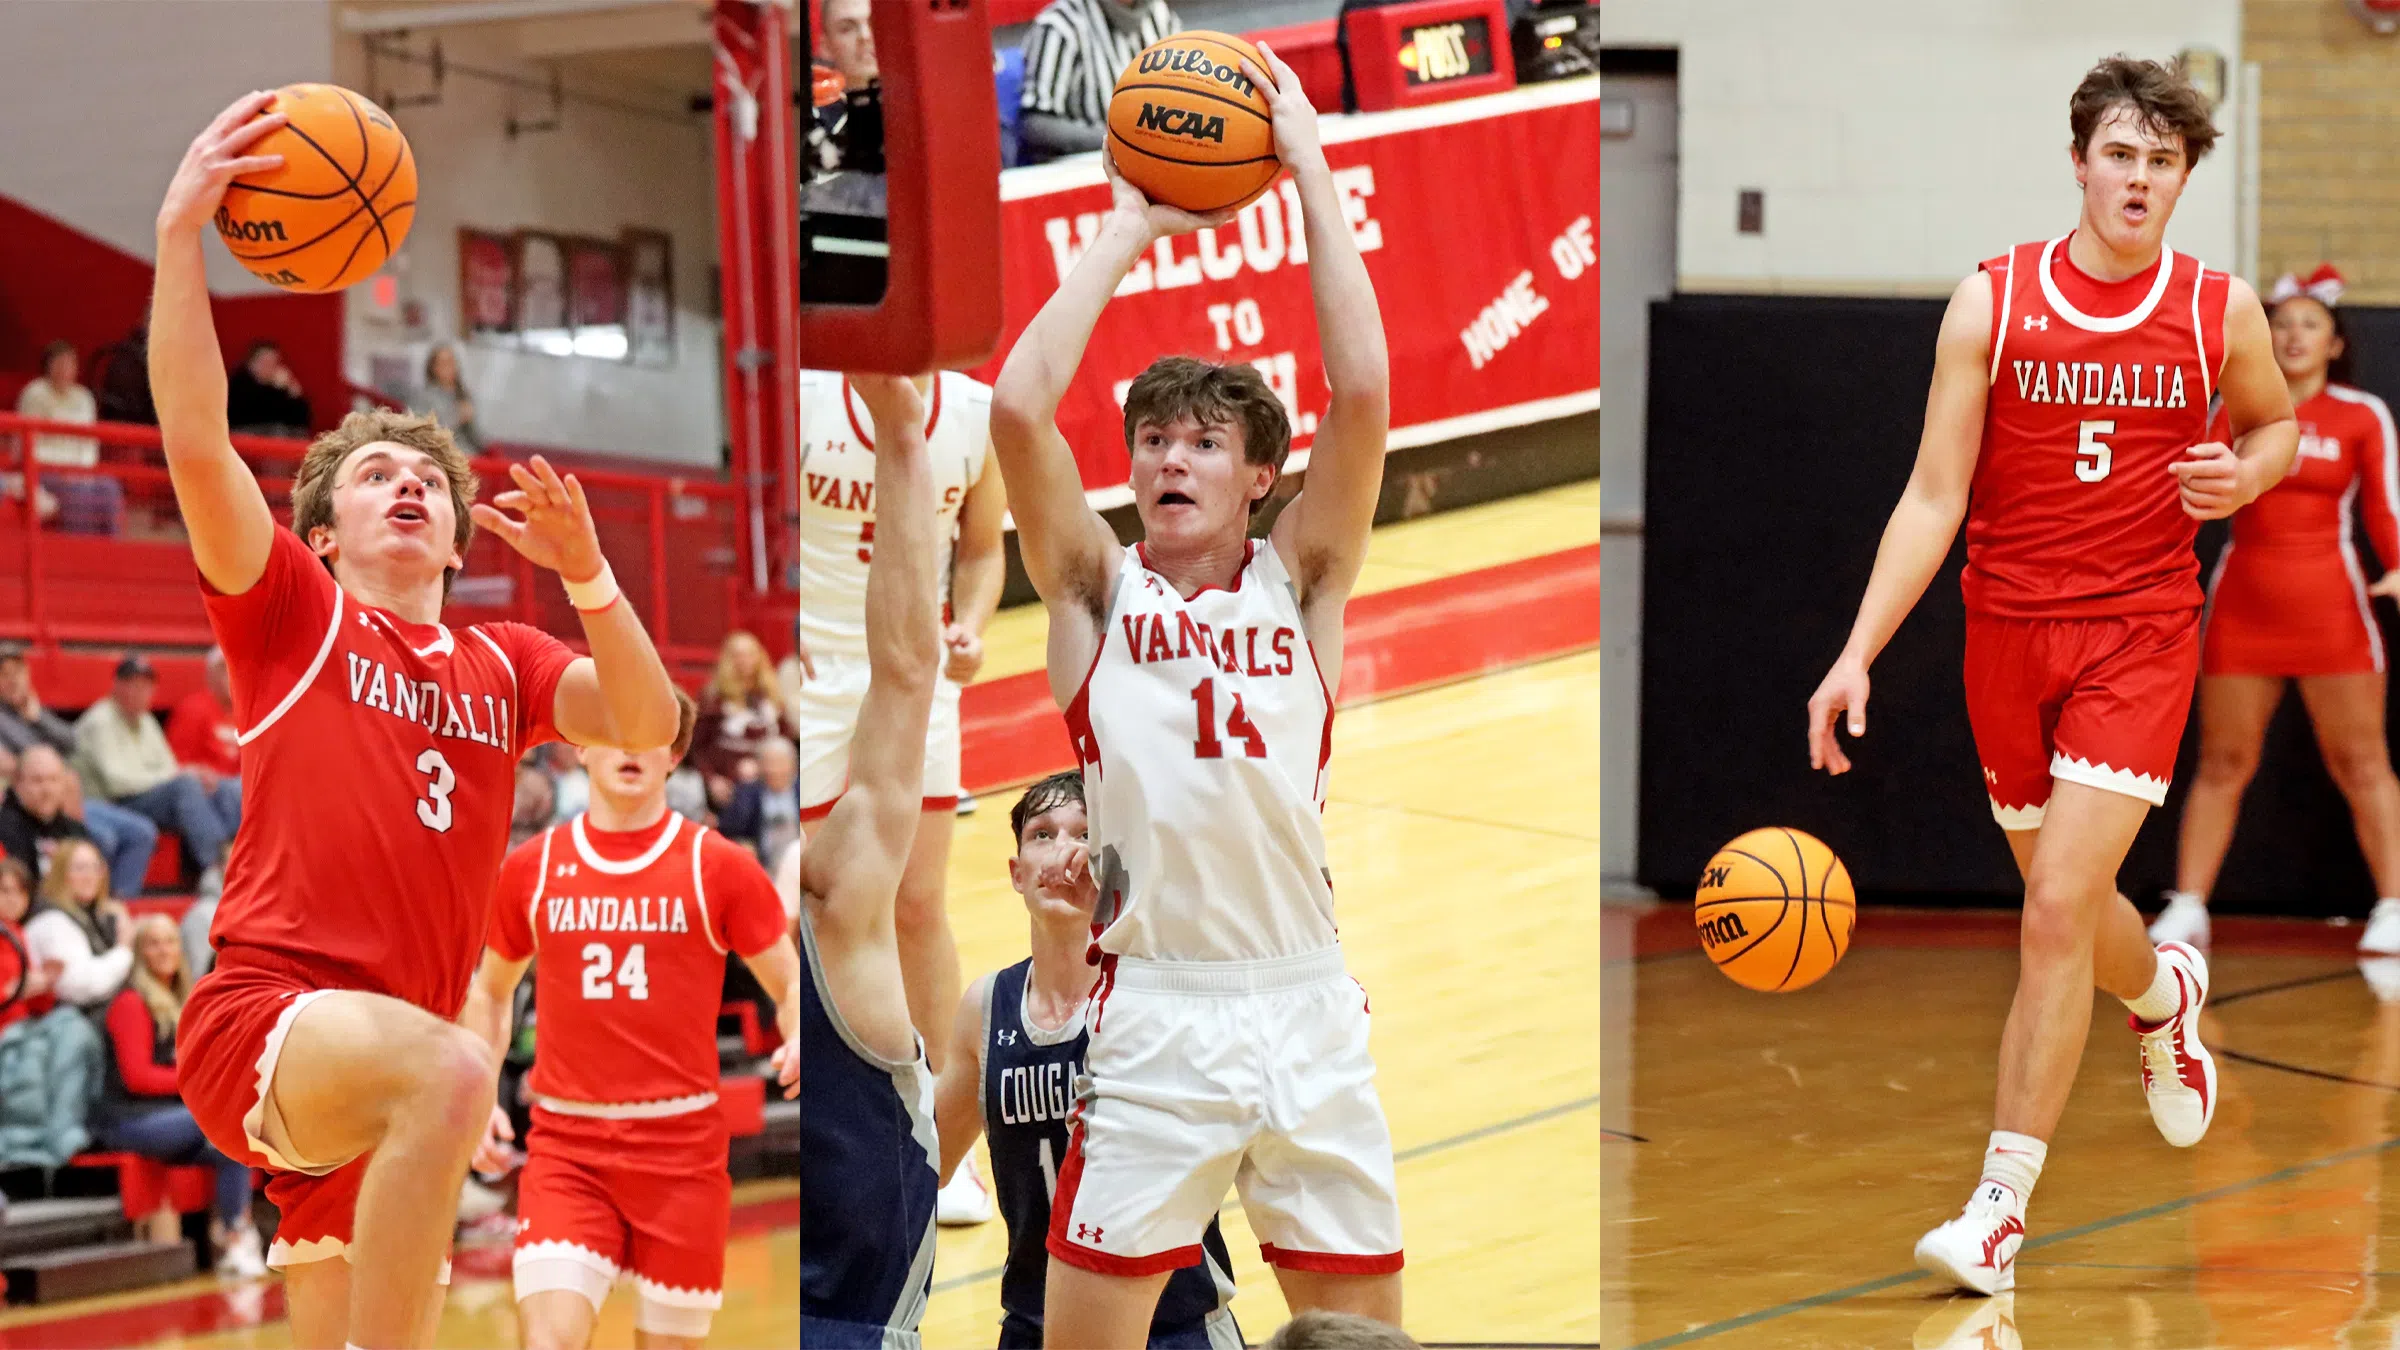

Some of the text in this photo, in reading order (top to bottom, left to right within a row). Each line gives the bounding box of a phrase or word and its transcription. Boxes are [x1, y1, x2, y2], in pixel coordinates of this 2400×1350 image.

[1139, 48, 1254, 99] Wilson
[1136, 102, 1226, 144] NCAA
[212, 204, 290, 243] lson
[1550, 213, 1597, 280] OF
[1207, 298, 1265, 351] TO
[2012, 359, 2188, 409] VANDALIA
[2074, 419, 2118, 483] 5
[1190, 676, 1268, 760] 14
[415, 747, 457, 834] 3
[547, 896, 689, 934] VANDALIA
[581, 942, 650, 1000] 24
